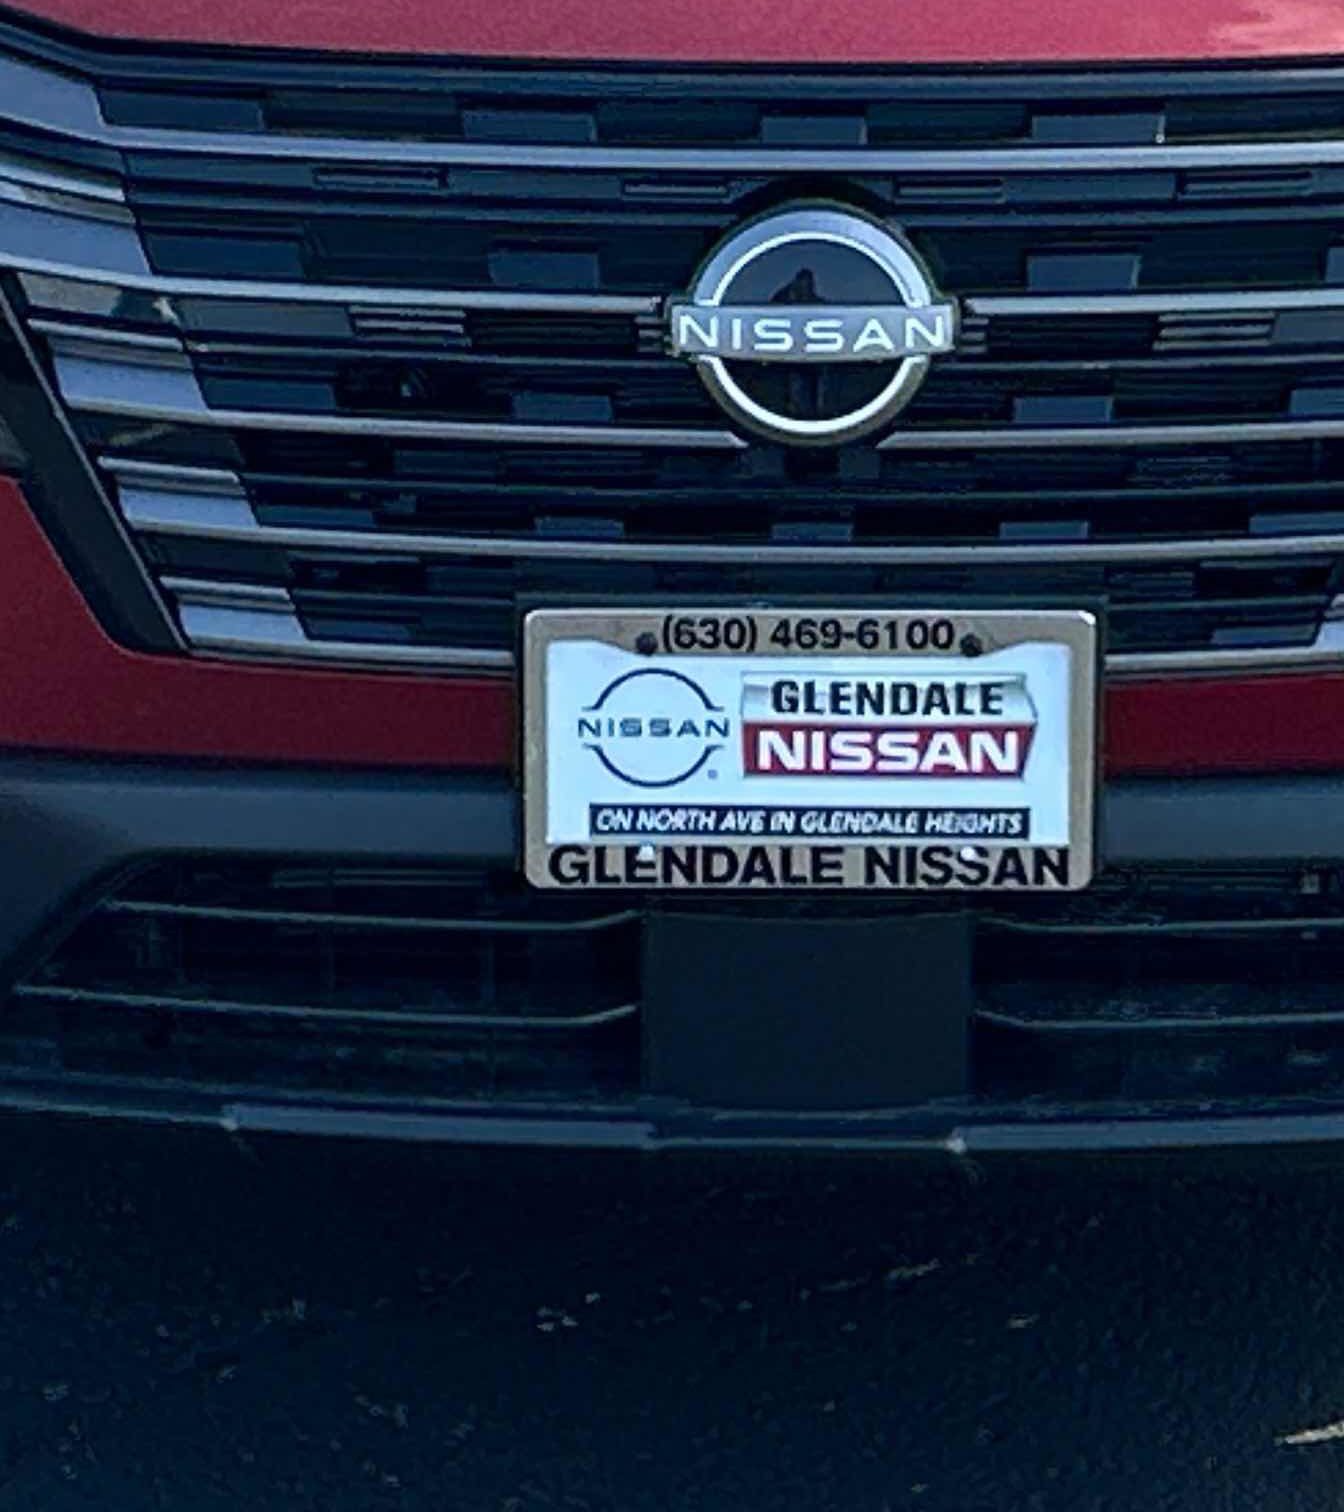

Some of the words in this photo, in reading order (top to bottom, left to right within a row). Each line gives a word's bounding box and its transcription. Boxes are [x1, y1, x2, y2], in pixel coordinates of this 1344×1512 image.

[678, 315, 944, 352] NISSAN
[661, 614, 758, 651] (630)
[769, 619, 955, 650] 469-6100
[771, 679, 1004, 716] GLENDALE
[577, 717, 730, 739] NISSAN
[758, 730, 1019, 774] NISSAN
[596, 807, 634, 831] ON
[635, 808, 716, 832] NORTH
[718, 810, 766, 833] AVE
[769, 810, 797, 833] IN
[800, 811, 918, 834] GLENDALE
[924, 811, 1023, 834] HEIGHTS
[549, 844, 845, 885] GLENDALE
[863, 845, 1070, 886] NISSAN
